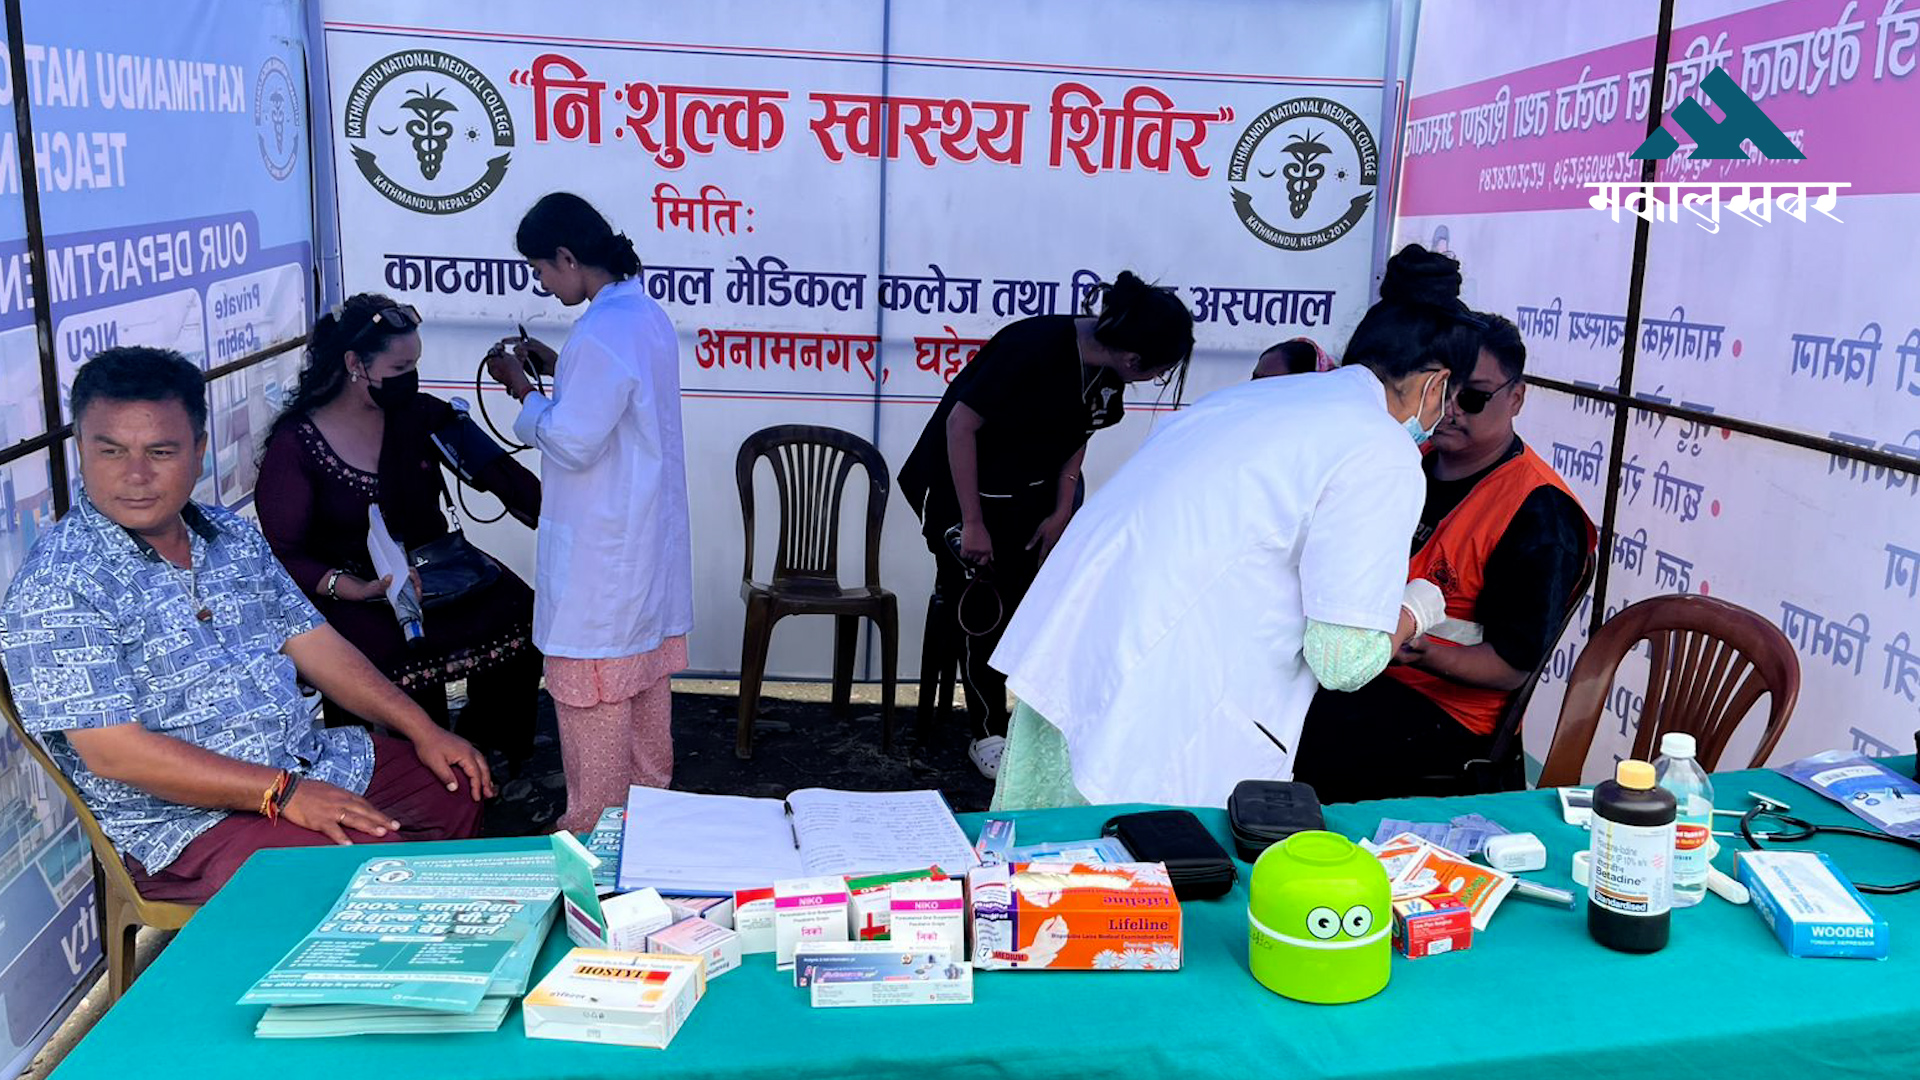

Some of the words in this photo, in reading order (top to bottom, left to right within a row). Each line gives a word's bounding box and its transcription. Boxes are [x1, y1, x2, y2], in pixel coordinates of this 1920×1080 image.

[348, 67, 384, 137] KATHMANDU
[381, 53, 437, 75] NATIONAL
[437, 56, 485, 92] MEDICAL
[482, 88, 511, 137] COLLEGE
[1230, 116, 1271, 181] KATHMANDU
[1270, 100, 1320, 123] NATIONAL
[1321, 102, 1361, 135] MEDICAL
[1356, 131, 1377, 177] COLLEGE
[438, 182, 491, 210] NEPAL-2011
[1300, 219, 1351, 246] NEPAL-2011
[726, 256, 866, 311] मेडिकल
[878, 264, 981, 315] कलेज
[1596, 865, 1642, 886] Betadine
[799, 896, 823, 905] NIKO
[914, 901, 938, 910] NIKO
[1595, 892, 1647, 912] Standardised
[1109, 918, 1169, 931] Lifeline
[1811, 926, 1874, 938] WOODEN
[578, 966, 644, 979] HOSTYL
